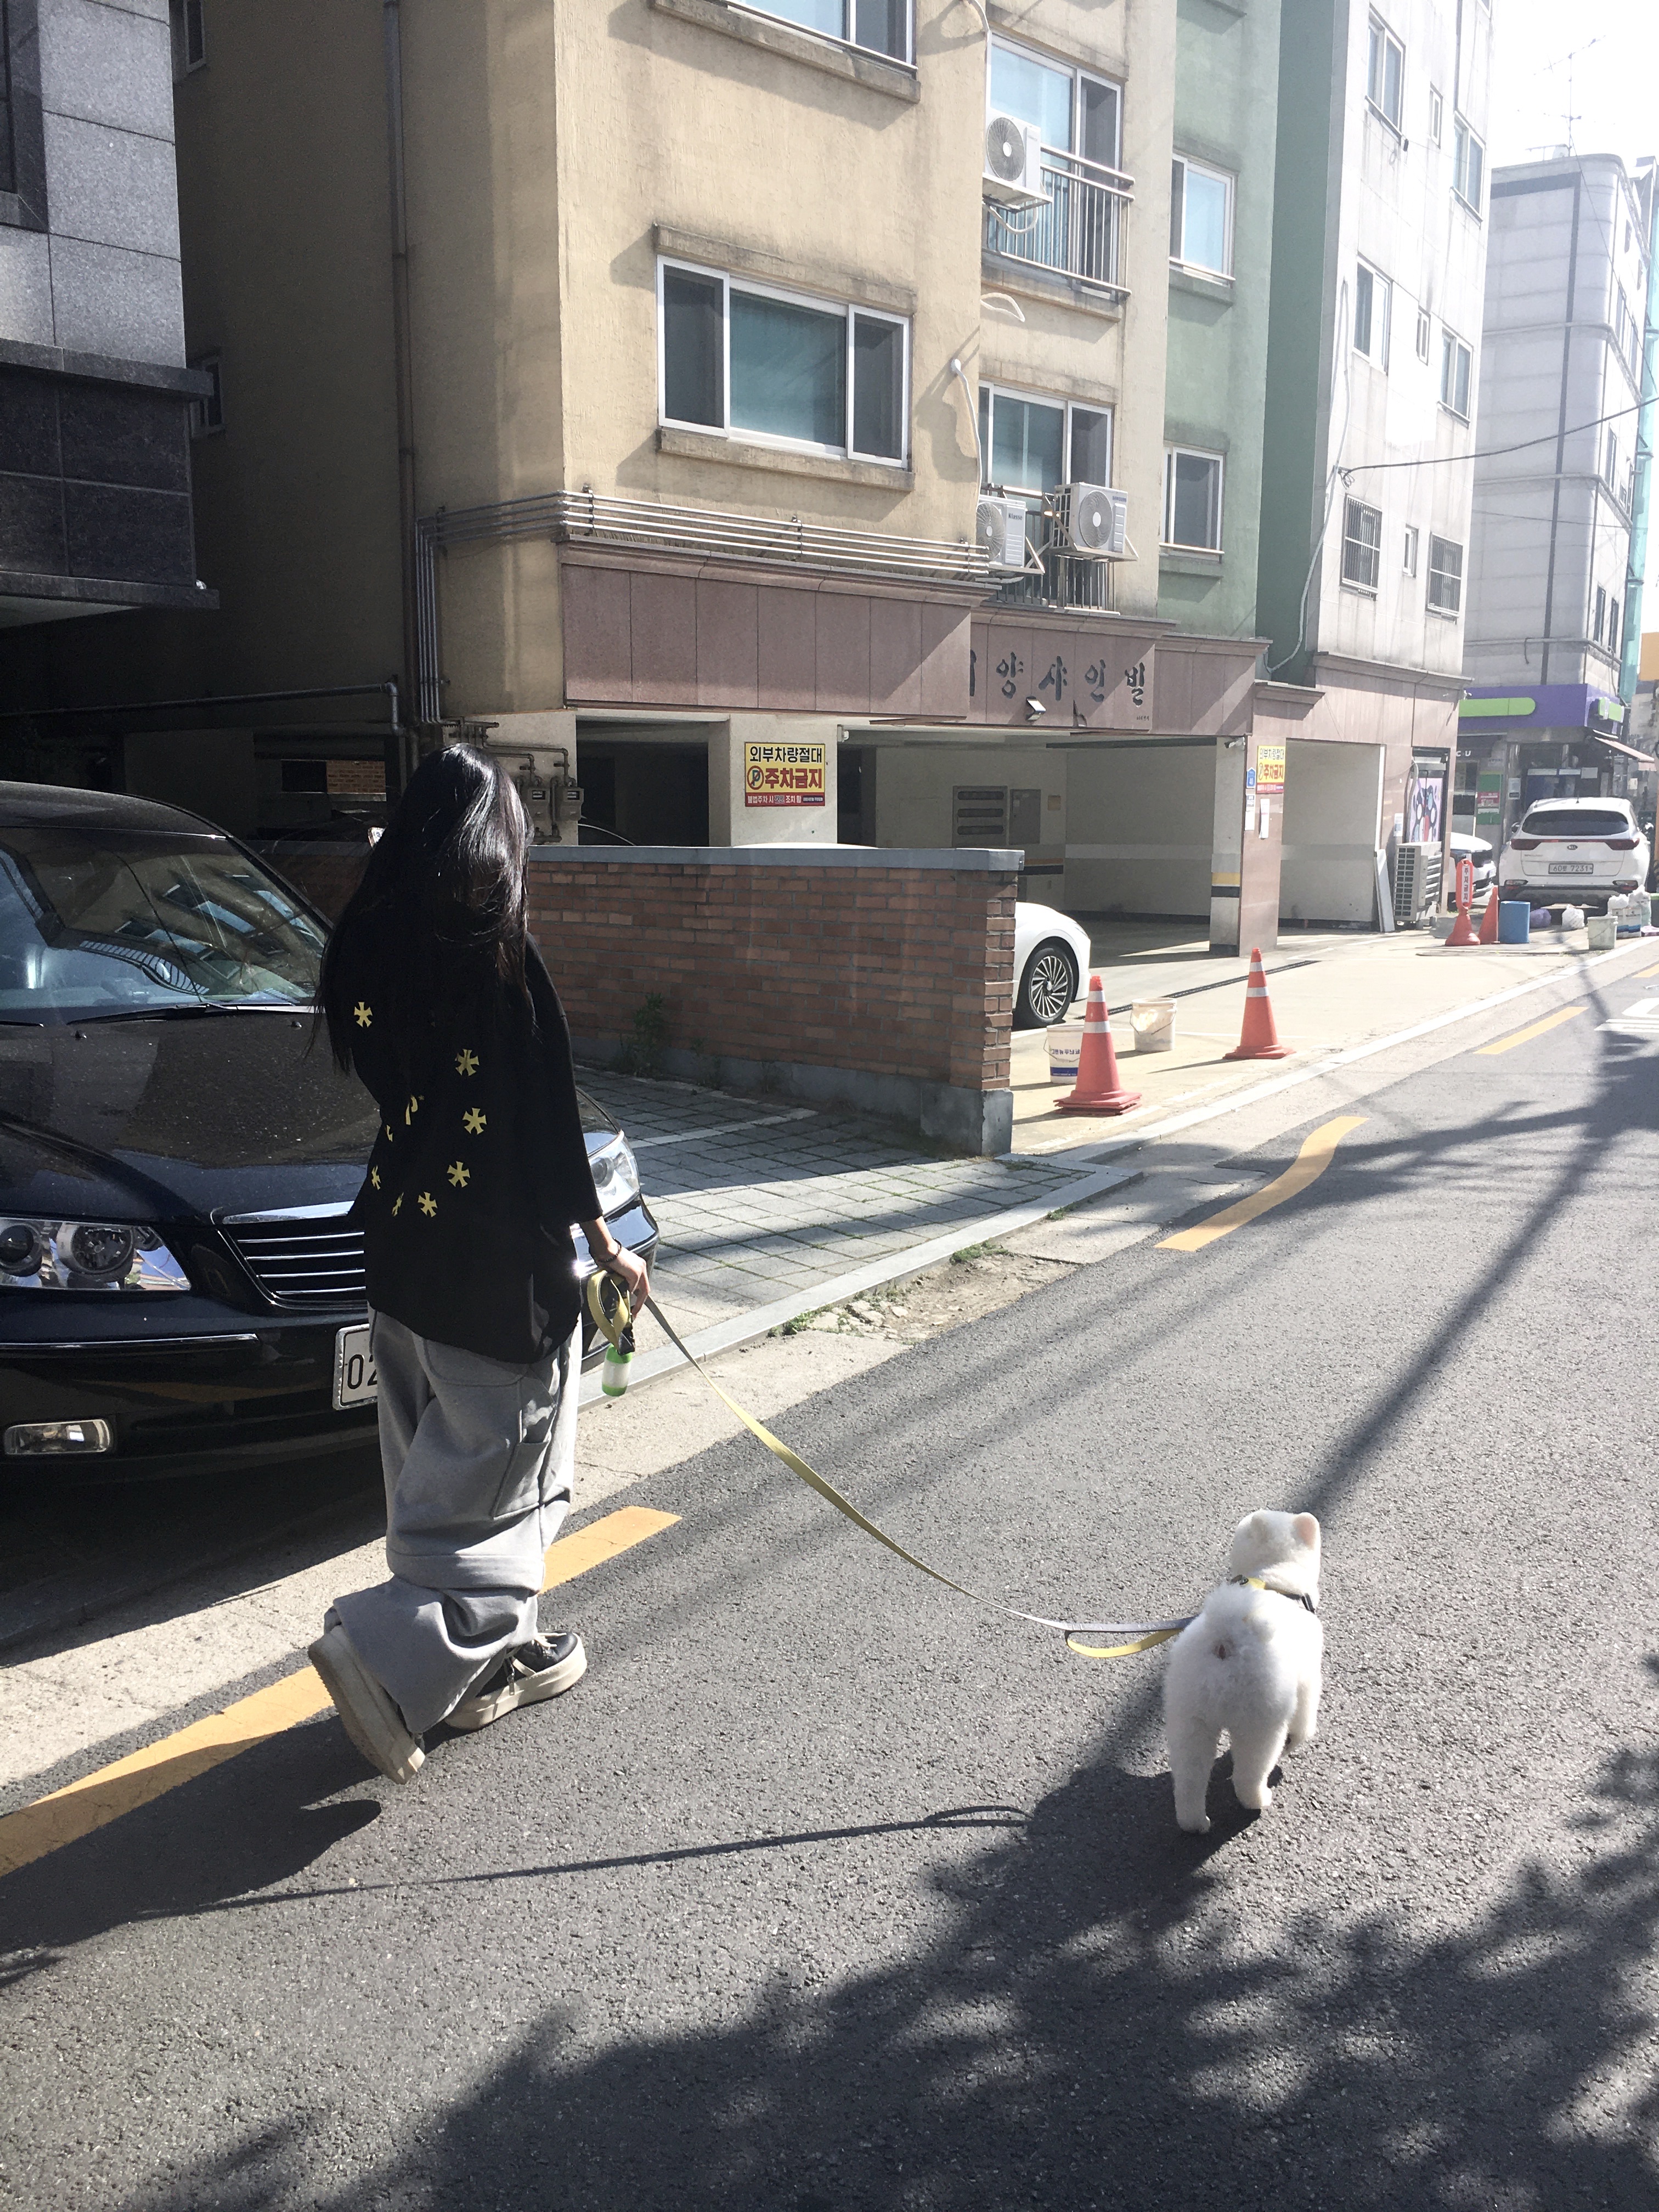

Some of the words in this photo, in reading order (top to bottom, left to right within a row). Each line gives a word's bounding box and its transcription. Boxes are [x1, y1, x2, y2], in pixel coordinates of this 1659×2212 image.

[970, 649, 1146, 707] 양샤인빌
[749, 746, 822, 763] 외부차량절대
[765, 768, 822, 789] 주차금지
[1263, 764, 1284, 780] 주차금지
